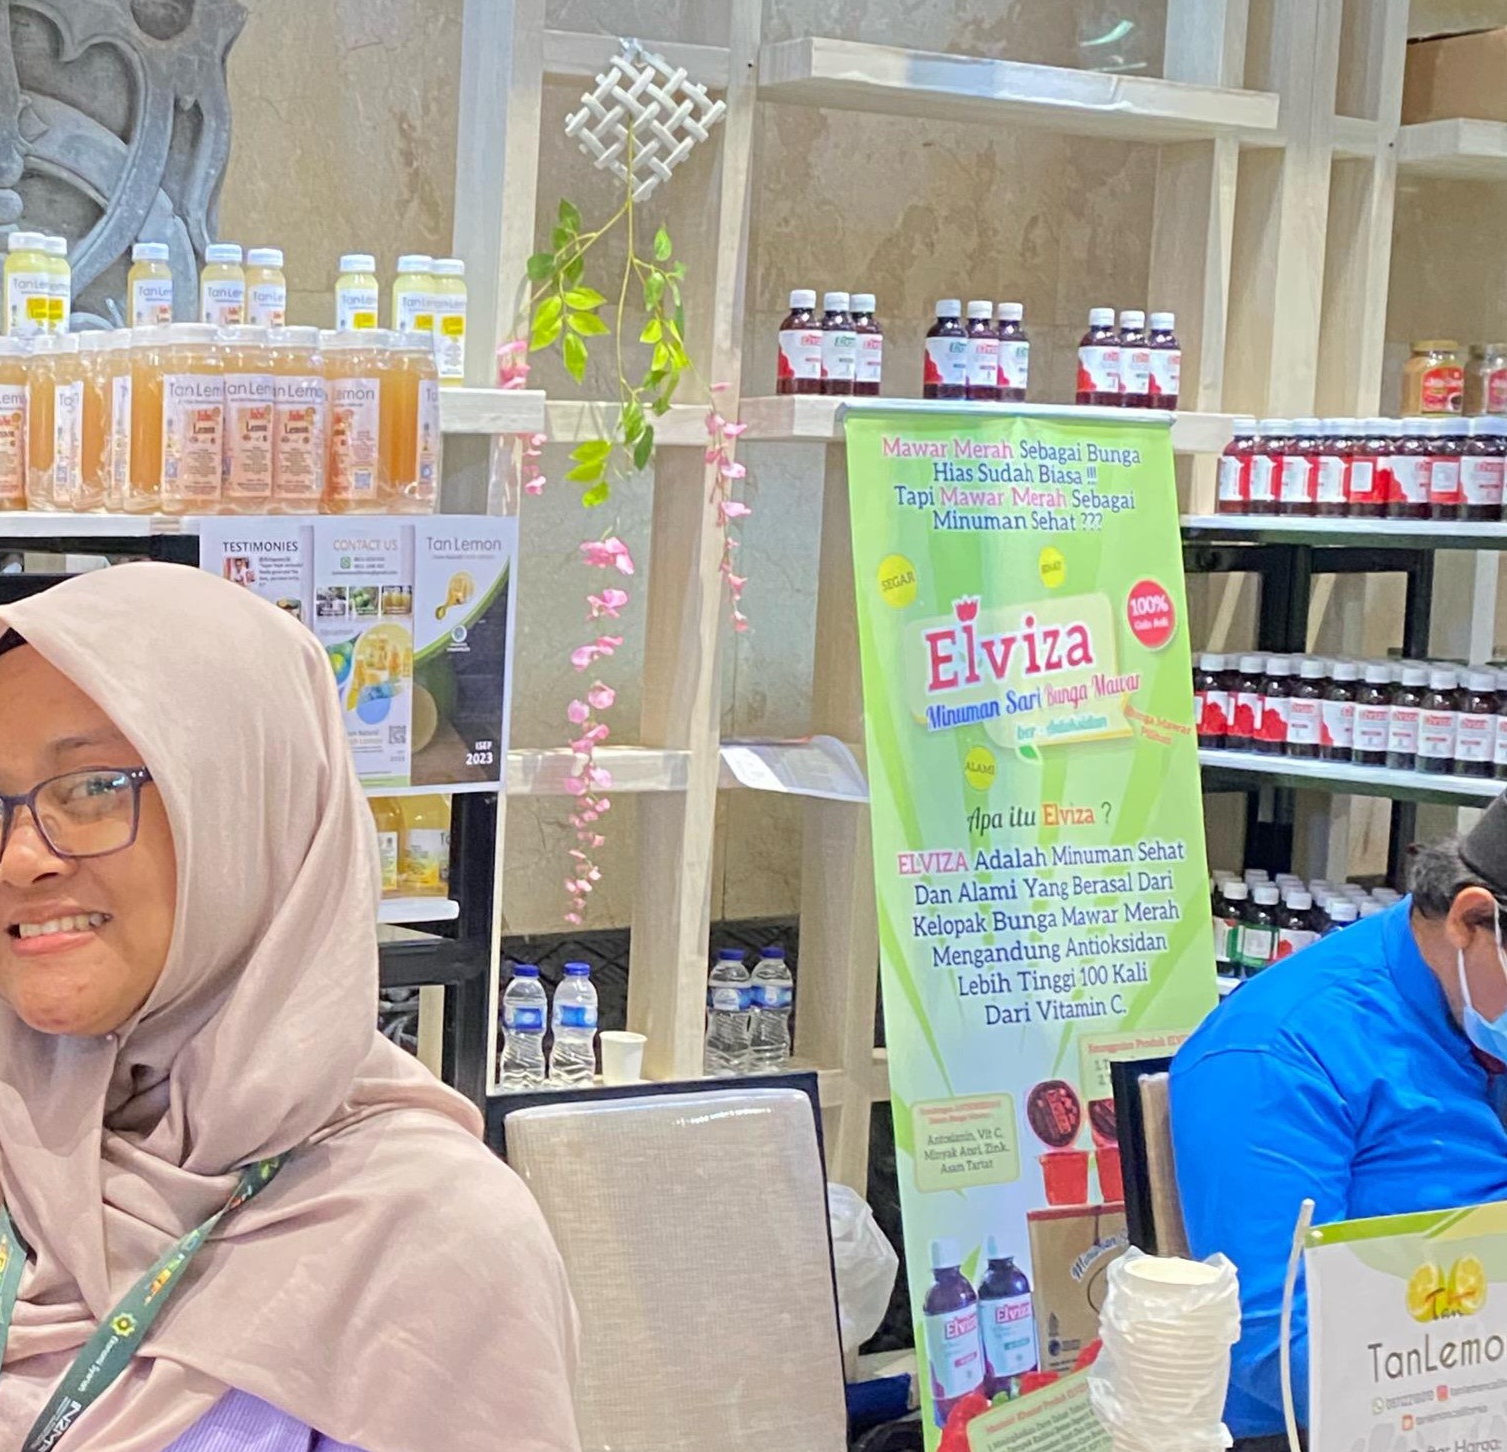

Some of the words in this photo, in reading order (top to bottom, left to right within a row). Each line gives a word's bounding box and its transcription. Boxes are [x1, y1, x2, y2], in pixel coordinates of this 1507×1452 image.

[170, 382, 194, 398] Tan
[882, 437, 948, 459] Mawar
[954, 438, 1013, 460] Merah
[1019, 440, 1084, 465] Sebagai
[1086, 443, 1141, 466] Bunga
[933, 462, 974, 483] Hias
[978, 463, 1034, 484] Sudah
[1038, 464, 1083, 485] Biasa
[1086, 466, 1097, 485] !!!
[894, 485, 936, 509] Tapi
[940, 487, 1004, 507] Mawar
[1011, 487, 1067, 508] Merah
[1071, 489, 1136, 512] Sebagai
[933, 510, 1027, 530] Minuman
[1031, 511, 1077, 531] Sehat
[1080, 512, 1103, 532] ???
[222, 541, 298, 552] TESTIMONIES
[333, 539, 380, 552] CONTACT
[382, 539, 398, 551] US
[426, 537, 452, 551] Tan
[454, 537, 502, 551] Lemon
[881, 571, 915, 592] SEGAR
[1131, 594, 1169, 616] 100%
[925, 612, 1094, 692] Elviza
[926, 699, 1000, 731] Minuman
[1005, 685, 1041, 716] Sari
[1044, 683, 1088, 710] Bunga
[1092, 671, 1141, 698] Mawar
[465, 751, 494, 766] 2023
[475, 741, 493, 751] ISEF
[965, 759, 995, 776] ALAMI
[967, 806, 1004, 837] Apa
[1009, 803, 1036, 829] itu
[1042, 803, 1095, 827] Elviza
[1101, 801, 1113, 824] ?
[898, 851, 969, 876] ELVIZA
[974, 849, 1048, 873] Adalah
[1051, 844, 1134, 868] Minuman
[1137, 840, 1185, 862] Sehat
[914, 884, 953, 907] Dan
[958, 879, 1018, 904] Alami
[1023, 877, 1069, 902] Yang
[1072, 873, 1133, 897] Berasal
[1137, 869, 1174, 892] Dari
[913, 911, 988, 941] Kelopak
[992, 909, 1058, 934] Bunga
[1061, 905, 1119, 928] Mawar
[1123, 899, 1180, 924] Merah
[932, 941, 1061, 969] Mengandung
[1065, 931, 1168, 960] Antioksidan
[958, 969, 1012, 998] Lebih
[1017, 967, 1077, 993] Tinggi
[1080, 965, 1109, 986] 100
[1112, 962, 1149, 984] Kali
[985, 1004, 1032, 1027] Dari
[1035, 998, 1108, 1022] Vitamin
[1110, 995, 1128, 1015] C.
